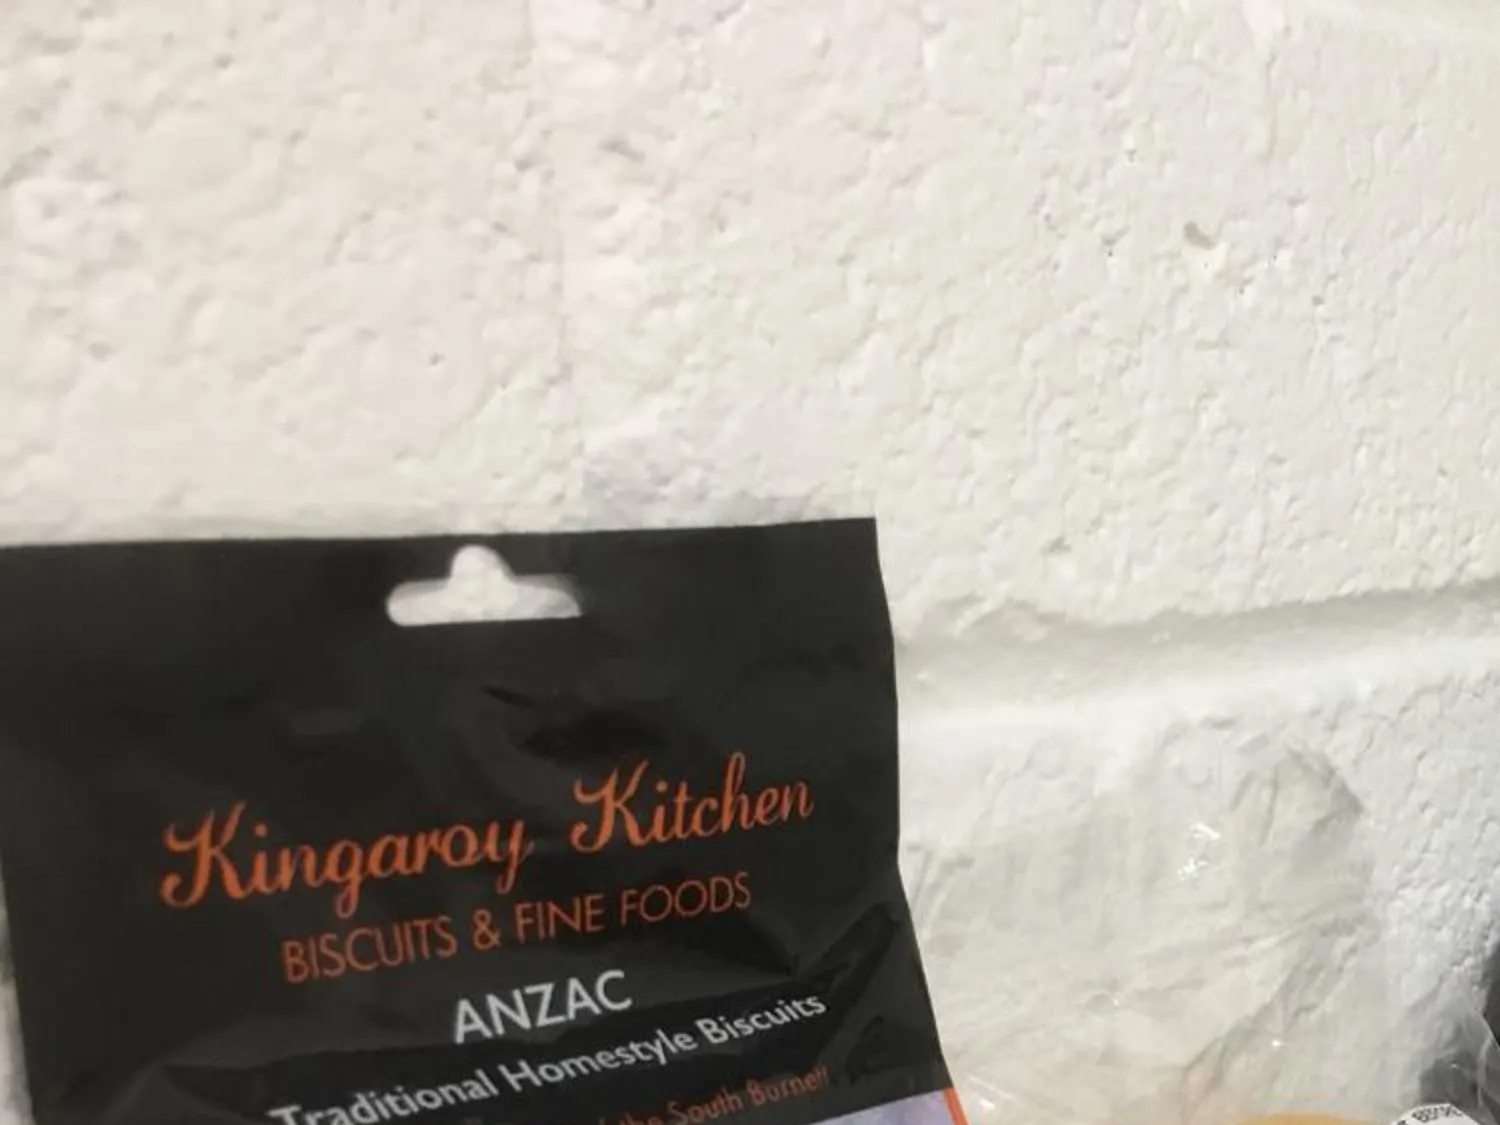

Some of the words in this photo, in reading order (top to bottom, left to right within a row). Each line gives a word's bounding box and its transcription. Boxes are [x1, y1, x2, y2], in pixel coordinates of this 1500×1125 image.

[160, 803, 535, 917] Kingaroy
[570, 752, 814, 853] Kitchen
[282, 916, 458, 983] BISCUITS
[472, 910, 500, 950] &
[516, 894, 605, 945] FINE
[621, 872, 752, 924] FOODS
[452, 970, 633, 1044] ANZAC
[499, 1024, 696, 1093] Homestyle
[700, 992, 827, 1046] Biscuits
[746, 1064, 832, 1108] Burnett
